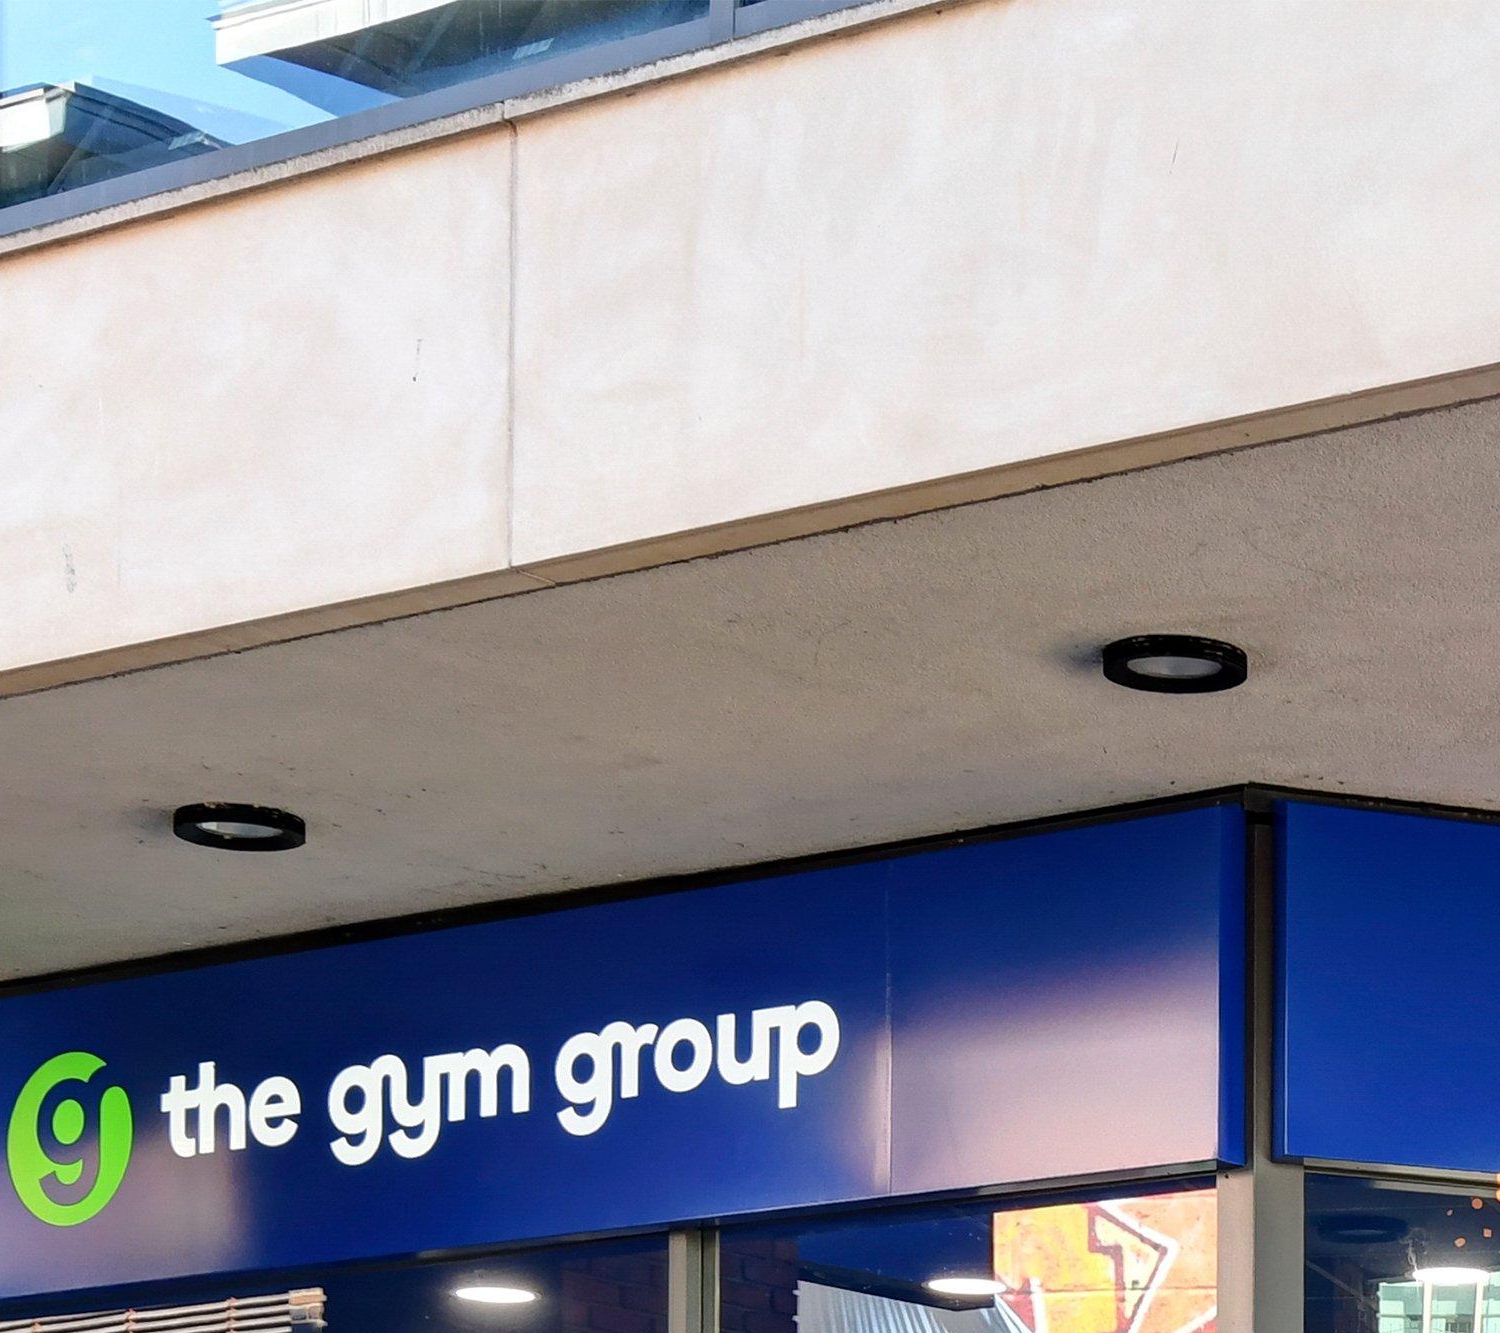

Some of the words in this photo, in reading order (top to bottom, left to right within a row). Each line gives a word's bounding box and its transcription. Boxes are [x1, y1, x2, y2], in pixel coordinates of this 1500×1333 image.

[160, 1062, 300, 1159] the
[328, 1044, 531, 1167] gym
[554, 1001, 841, 1137] group
